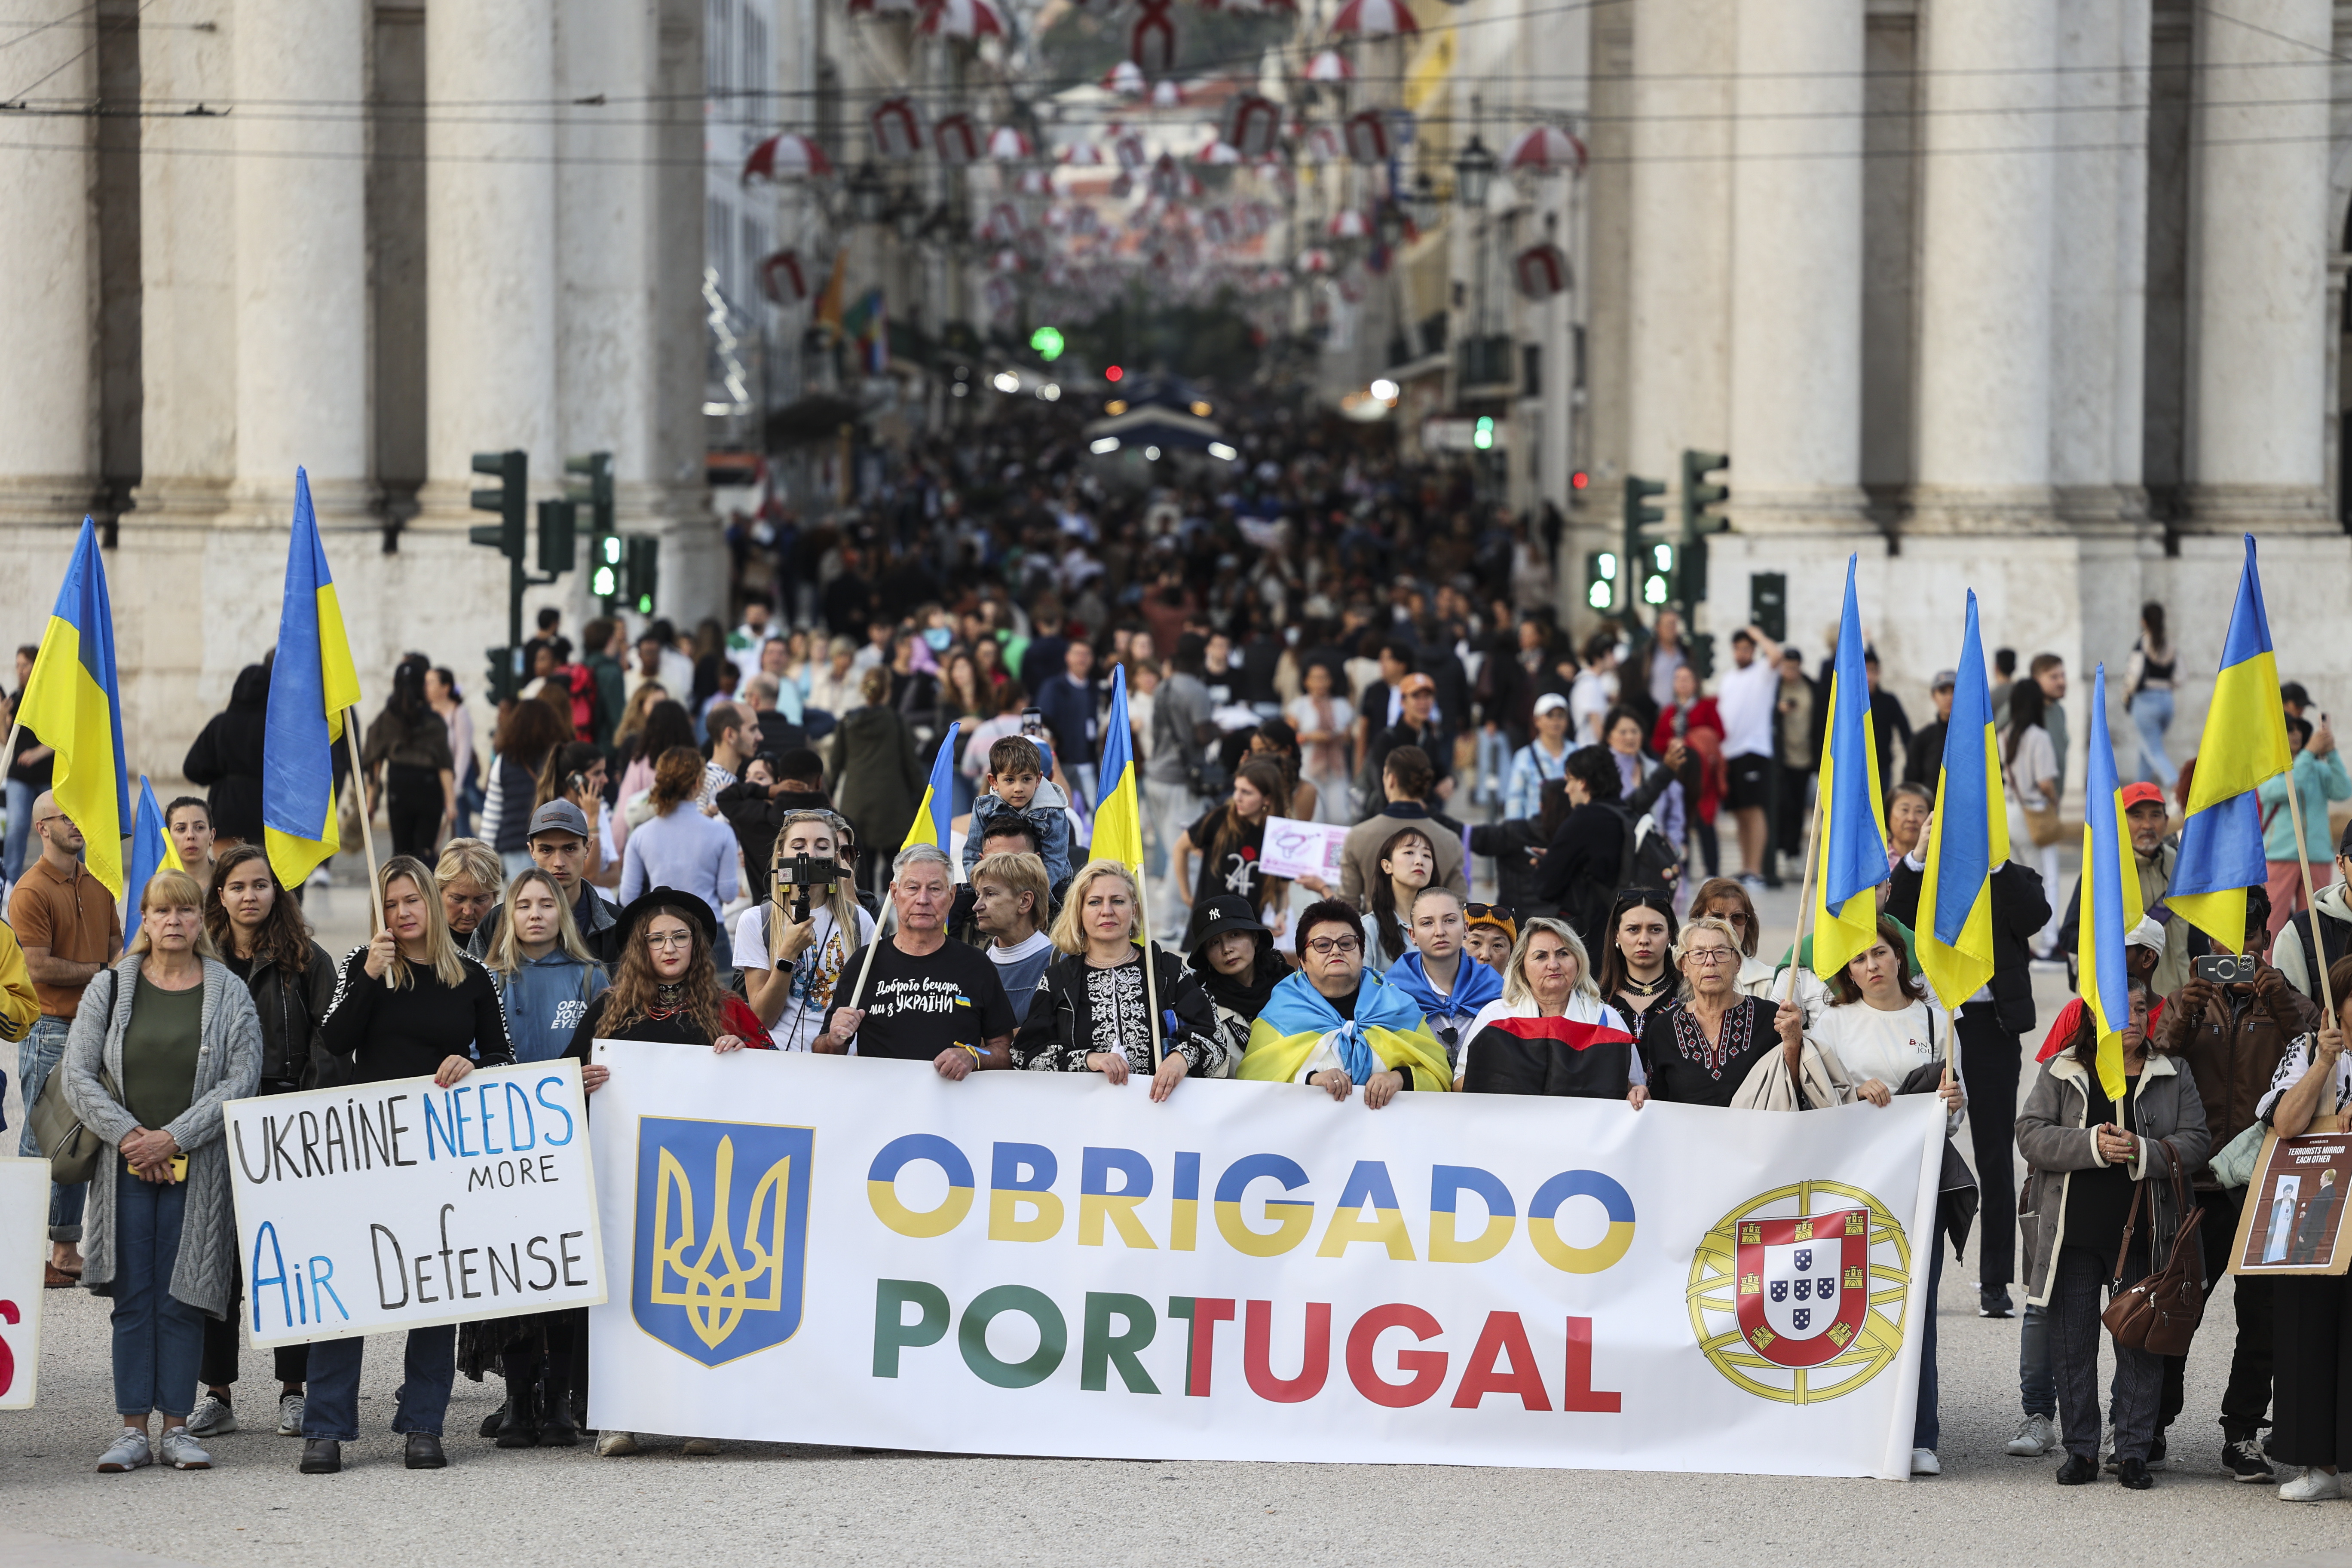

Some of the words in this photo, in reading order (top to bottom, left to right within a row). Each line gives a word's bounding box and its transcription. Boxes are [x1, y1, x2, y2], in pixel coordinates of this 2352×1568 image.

[1209, 908, 1221, 921] NY
[876, 978, 921, 997] Доброго
[922, 977, 962, 995] вечора,
[557, 1000, 588, 1010] OPEN
[869, 1004, 886, 1015] ми
[887, 1002, 894, 1017] з
[896, 992, 953, 1013] УКРАЇНИ
[556, 1010, 586, 1019] YOUR
[1909, 1038, 1927, 1048] BON
[423, 1076, 574, 1161] NEEDS
[2288, 1147, 2321, 1156] TERRORISTS
[2322, 1145, 2346, 1154] MIRROR
[2295, 1156, 2312, 1164] EACH
[2312, 1155, 2331, 1163] OTHER
[468, 1155, 559, 1192] MORE
[867, 1133, 1636, 1274] OBRIGADO
[873, 1279, 1622, 1414] PORTUGAL
